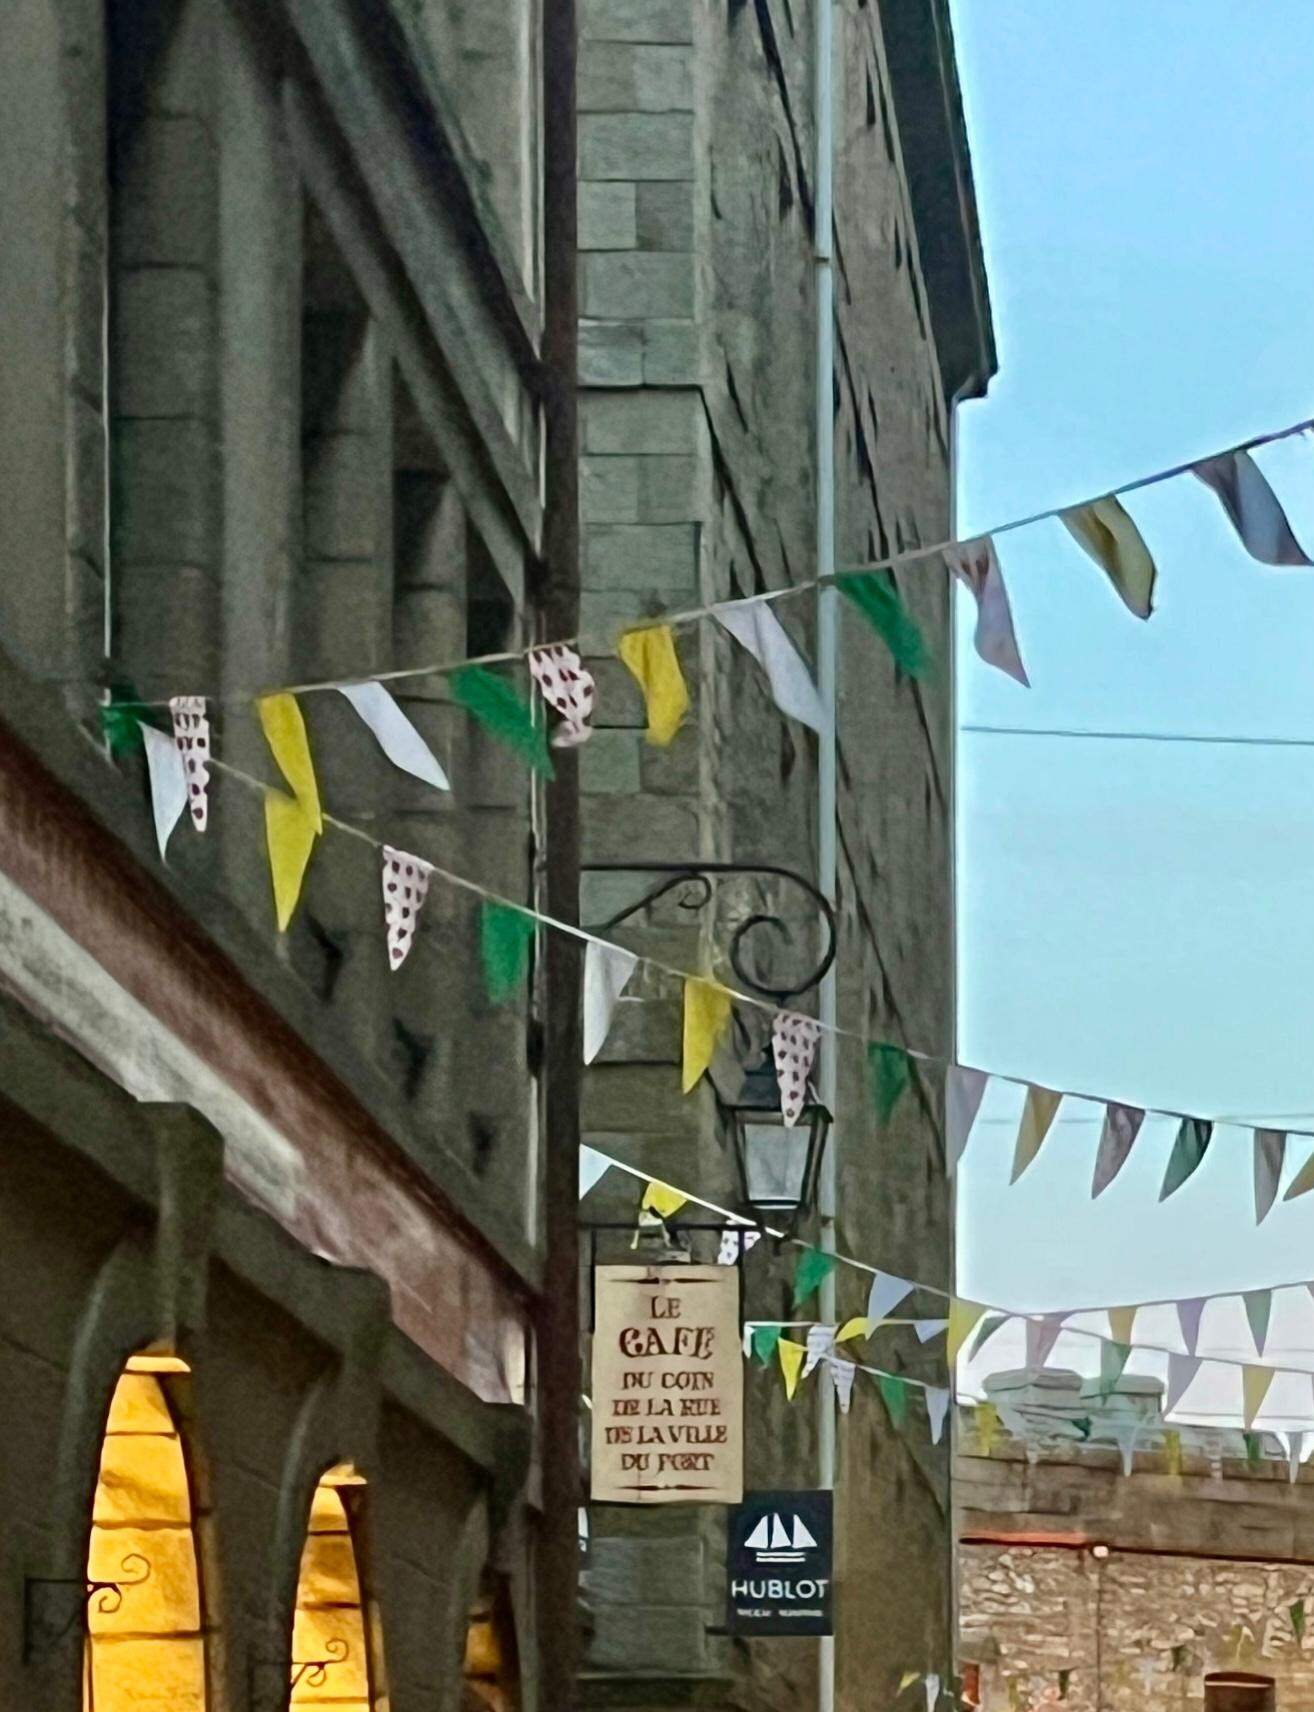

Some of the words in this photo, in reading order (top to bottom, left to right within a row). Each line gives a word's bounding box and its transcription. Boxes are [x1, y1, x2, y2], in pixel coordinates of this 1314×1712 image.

[650, 1295, 682, 1319] LE
[621, 1371, 654, 1391] DU
[661, 1371, 715, 1391] COIN
[612, 1398, 640, 1417] DE
[646, 1398, 674, 1417] LA
[679, 1398, 721, 1417] RUE
[604, 1426, 633, 1445] DE
[636, 1425, 665, 1445] LA
[667, 1424, 729, 1445] VILLE
[621, 1452, 650, 1472] DU
[657, 1452, 716, 1474] PORT
[731, 1578, 829, 1600] HUBLOT
